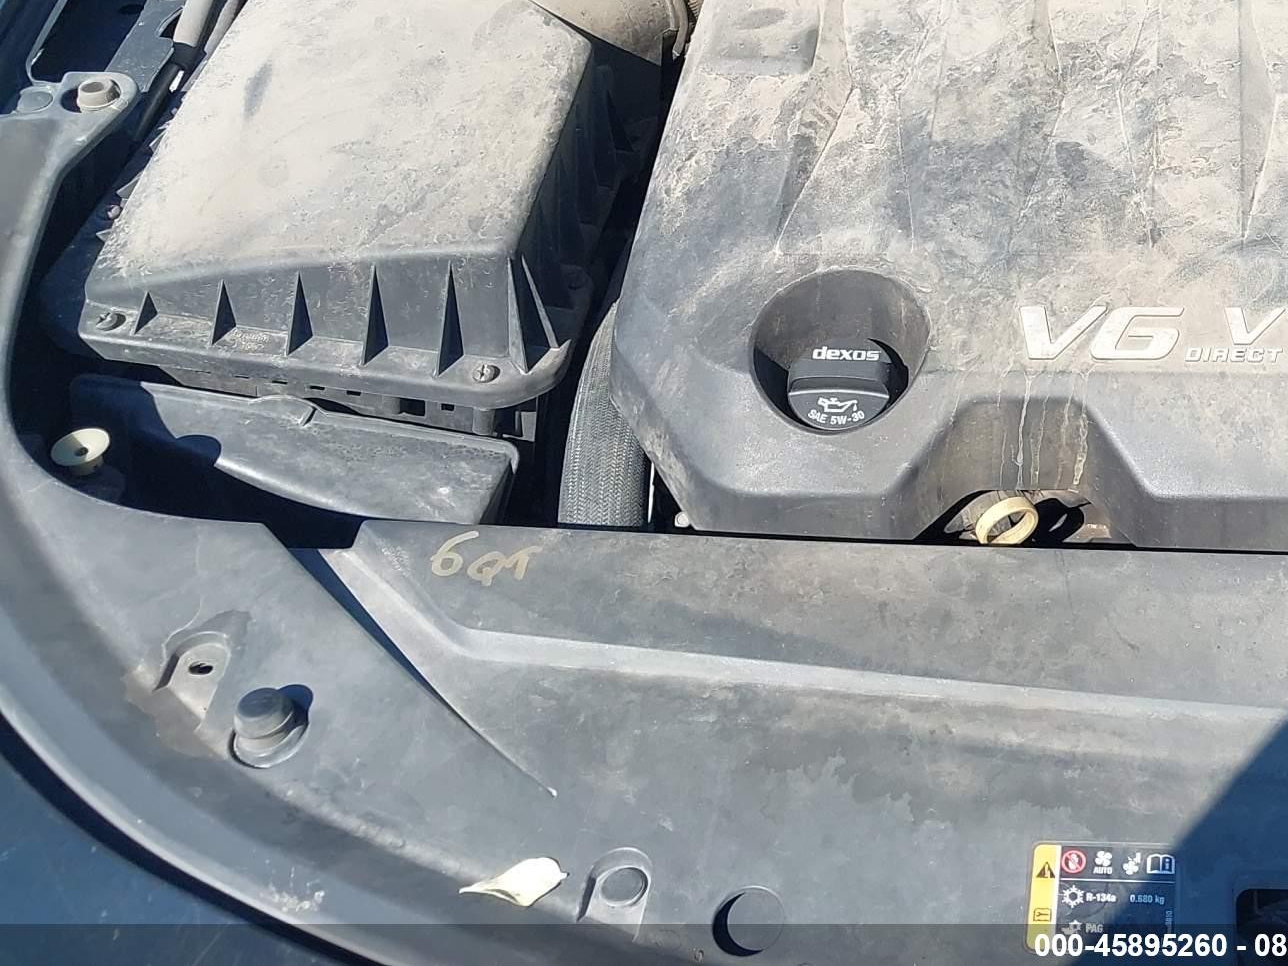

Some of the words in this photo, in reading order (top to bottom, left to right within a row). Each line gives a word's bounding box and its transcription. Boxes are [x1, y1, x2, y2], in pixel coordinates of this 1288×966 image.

[1019, 305, 1185, 361] V6
[811, 345, 881, 362] dexos
[1184, 346, 1284, 364] DIRECT
[807, 408, 828, 424] SAE
[830, 410, 866, 425] 5W-30
[1092, 866, 1113, 875] AUTO
[1085, 892, 1117, 903] R-134a
[1154, 894, 1165, 906] kg
[1085, 922, 1104, 934] PAG
